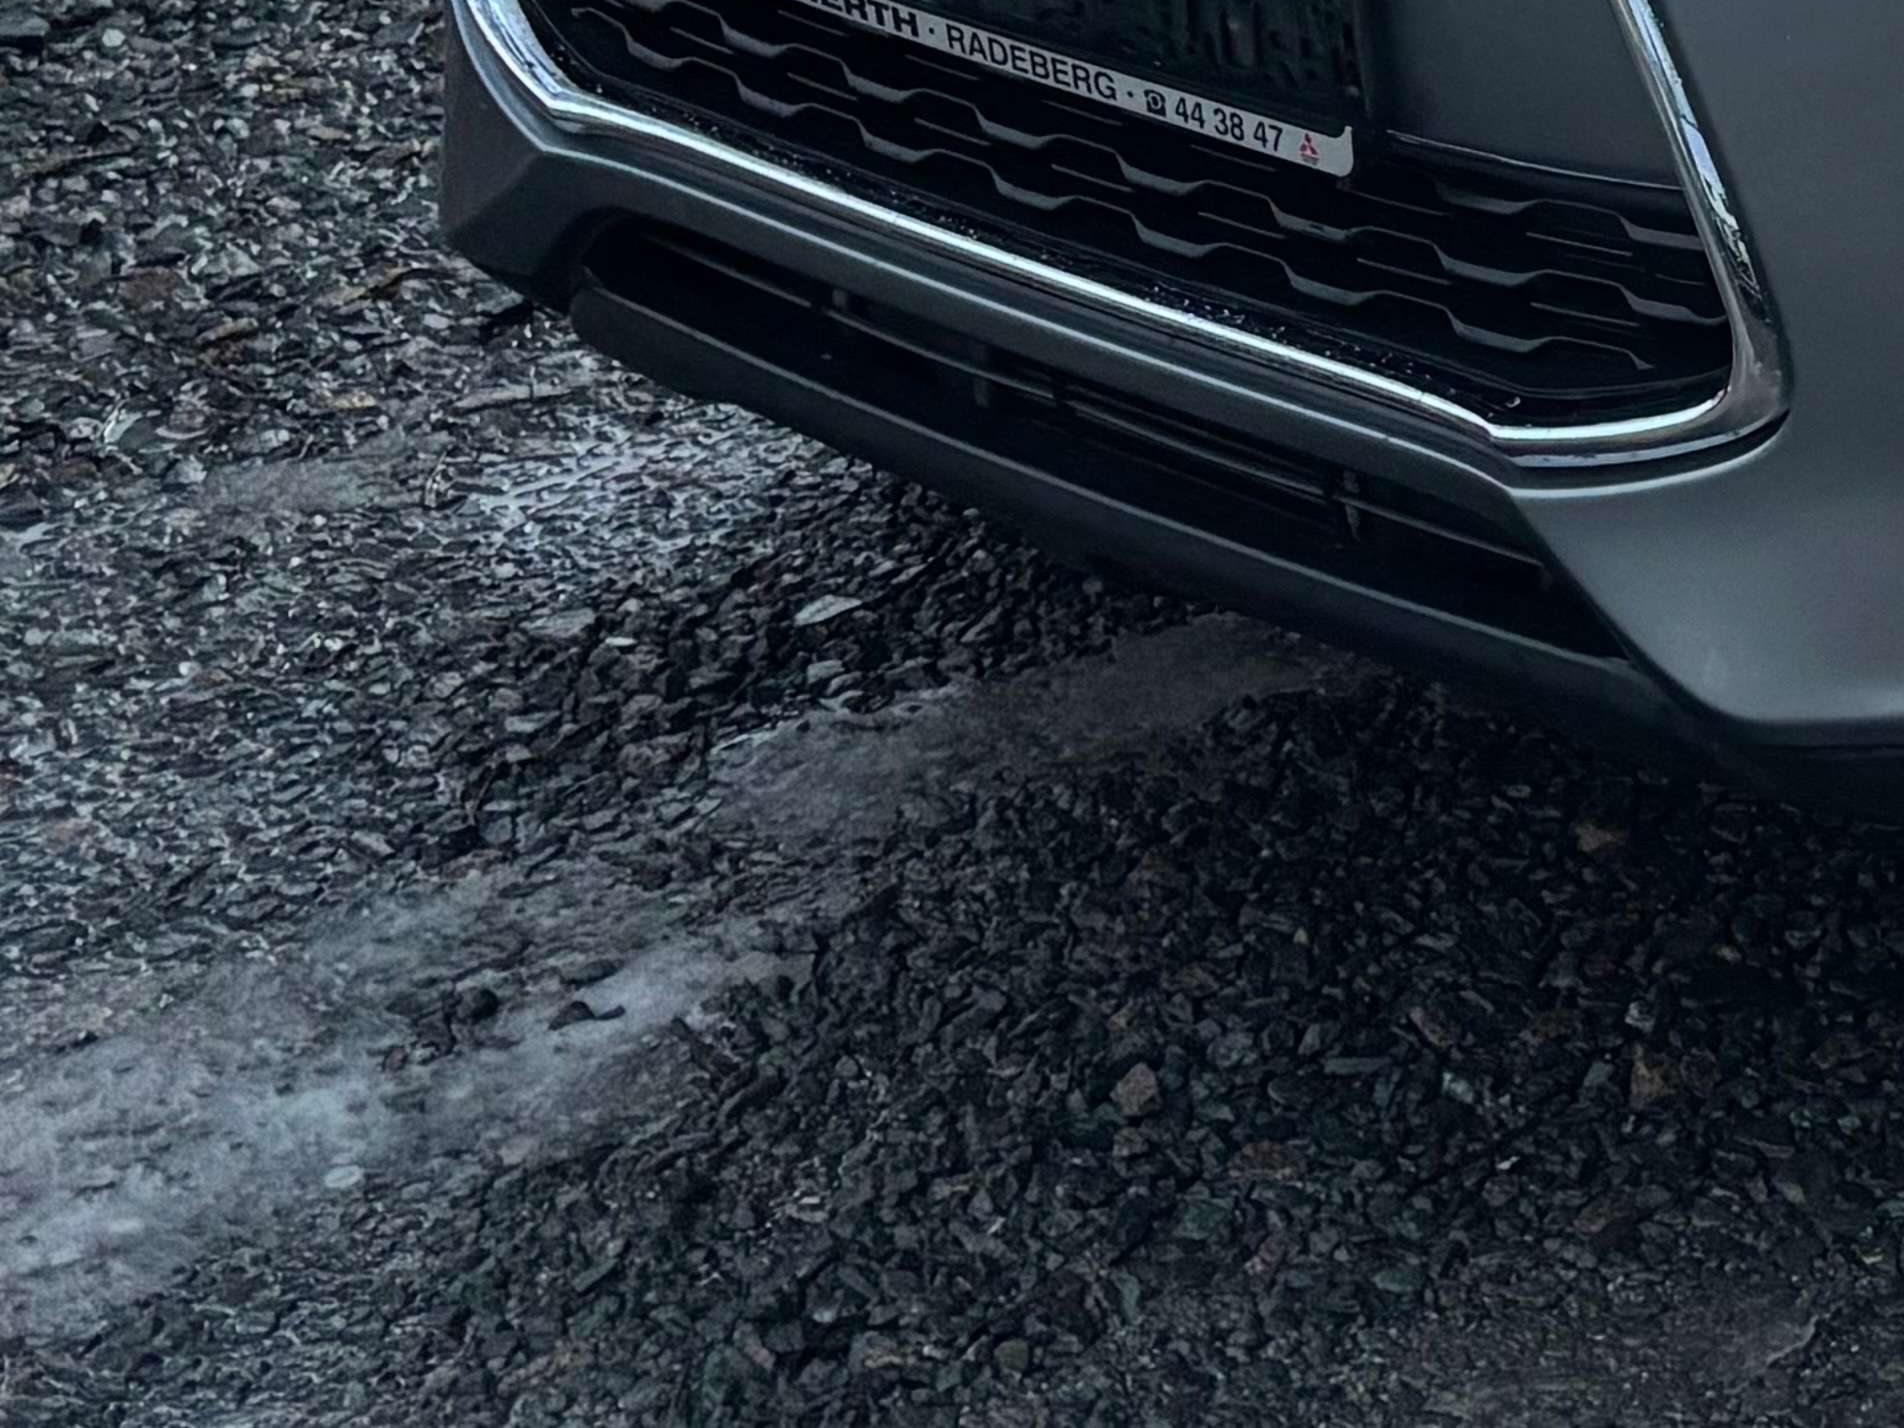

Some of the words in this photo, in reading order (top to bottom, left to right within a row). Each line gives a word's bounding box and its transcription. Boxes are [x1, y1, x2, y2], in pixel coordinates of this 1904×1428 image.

[945, 23, 1118, 102] RADEBERG
[1175, 97, 1206, 130] 44
[1214, 107, 1246, 142] 38
[1252, 119, 1284, 153] 47
